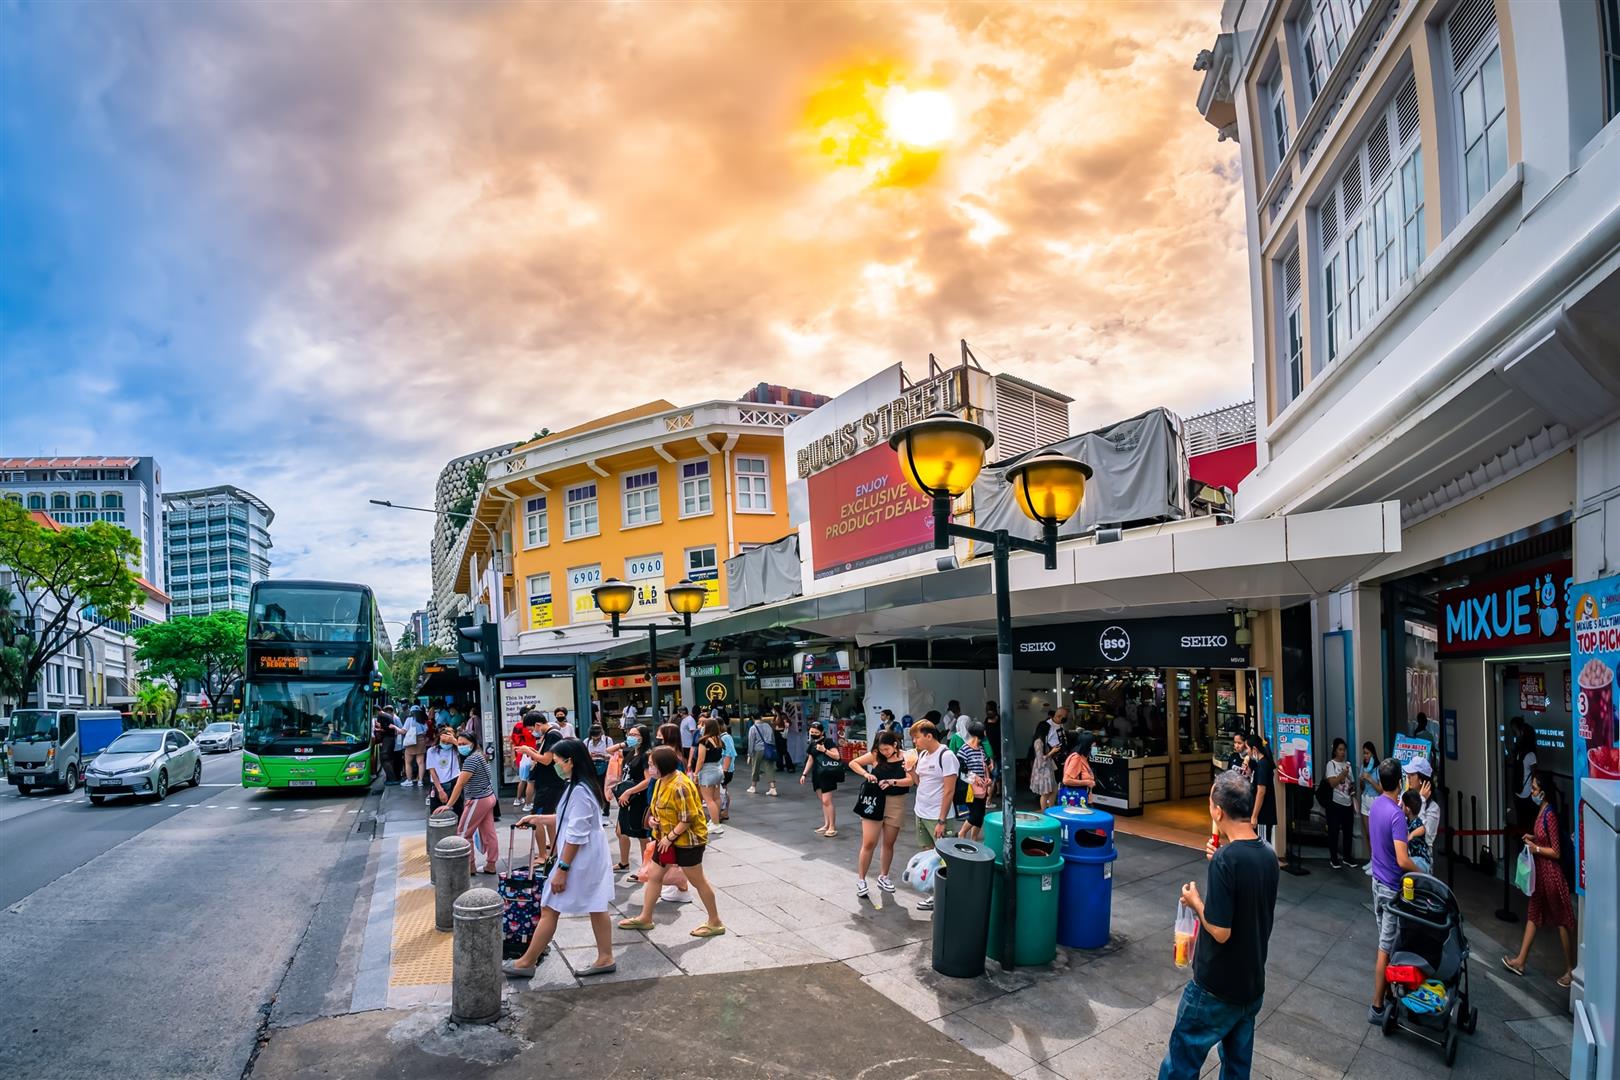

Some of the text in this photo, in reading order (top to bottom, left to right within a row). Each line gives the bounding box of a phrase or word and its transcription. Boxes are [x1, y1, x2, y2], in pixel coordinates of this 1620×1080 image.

[796, 371, 953, 479] BUGIS STREET
[855, 475, 889, 497] ENJOY
[840, 482, 908, 519] EXCLUSIVE
[825, 494, 931, 540] PRODUCT DEALS
[897, 548, 907, 556] call
[631, 559, 662, 576] 0960
[573, 569, 600, 584] 6902
[1446, 584, 1532, 645] MIXUE
[1598, 616, 1609, 628] ALL
[1019, 641, 1056, 652] SEIKO
[1103, 638, 1126, 649] BSO
[1180, 635, 1228, 648] SEIKO
[1577, 631, 1597, 652] TOP
[346, 656, 355, 670] 7
[1521, 684, 1539, 694] ORDER
[1579, 694, 1588, 714] 3
[1088, 756, 1114, 765] SEIKO
